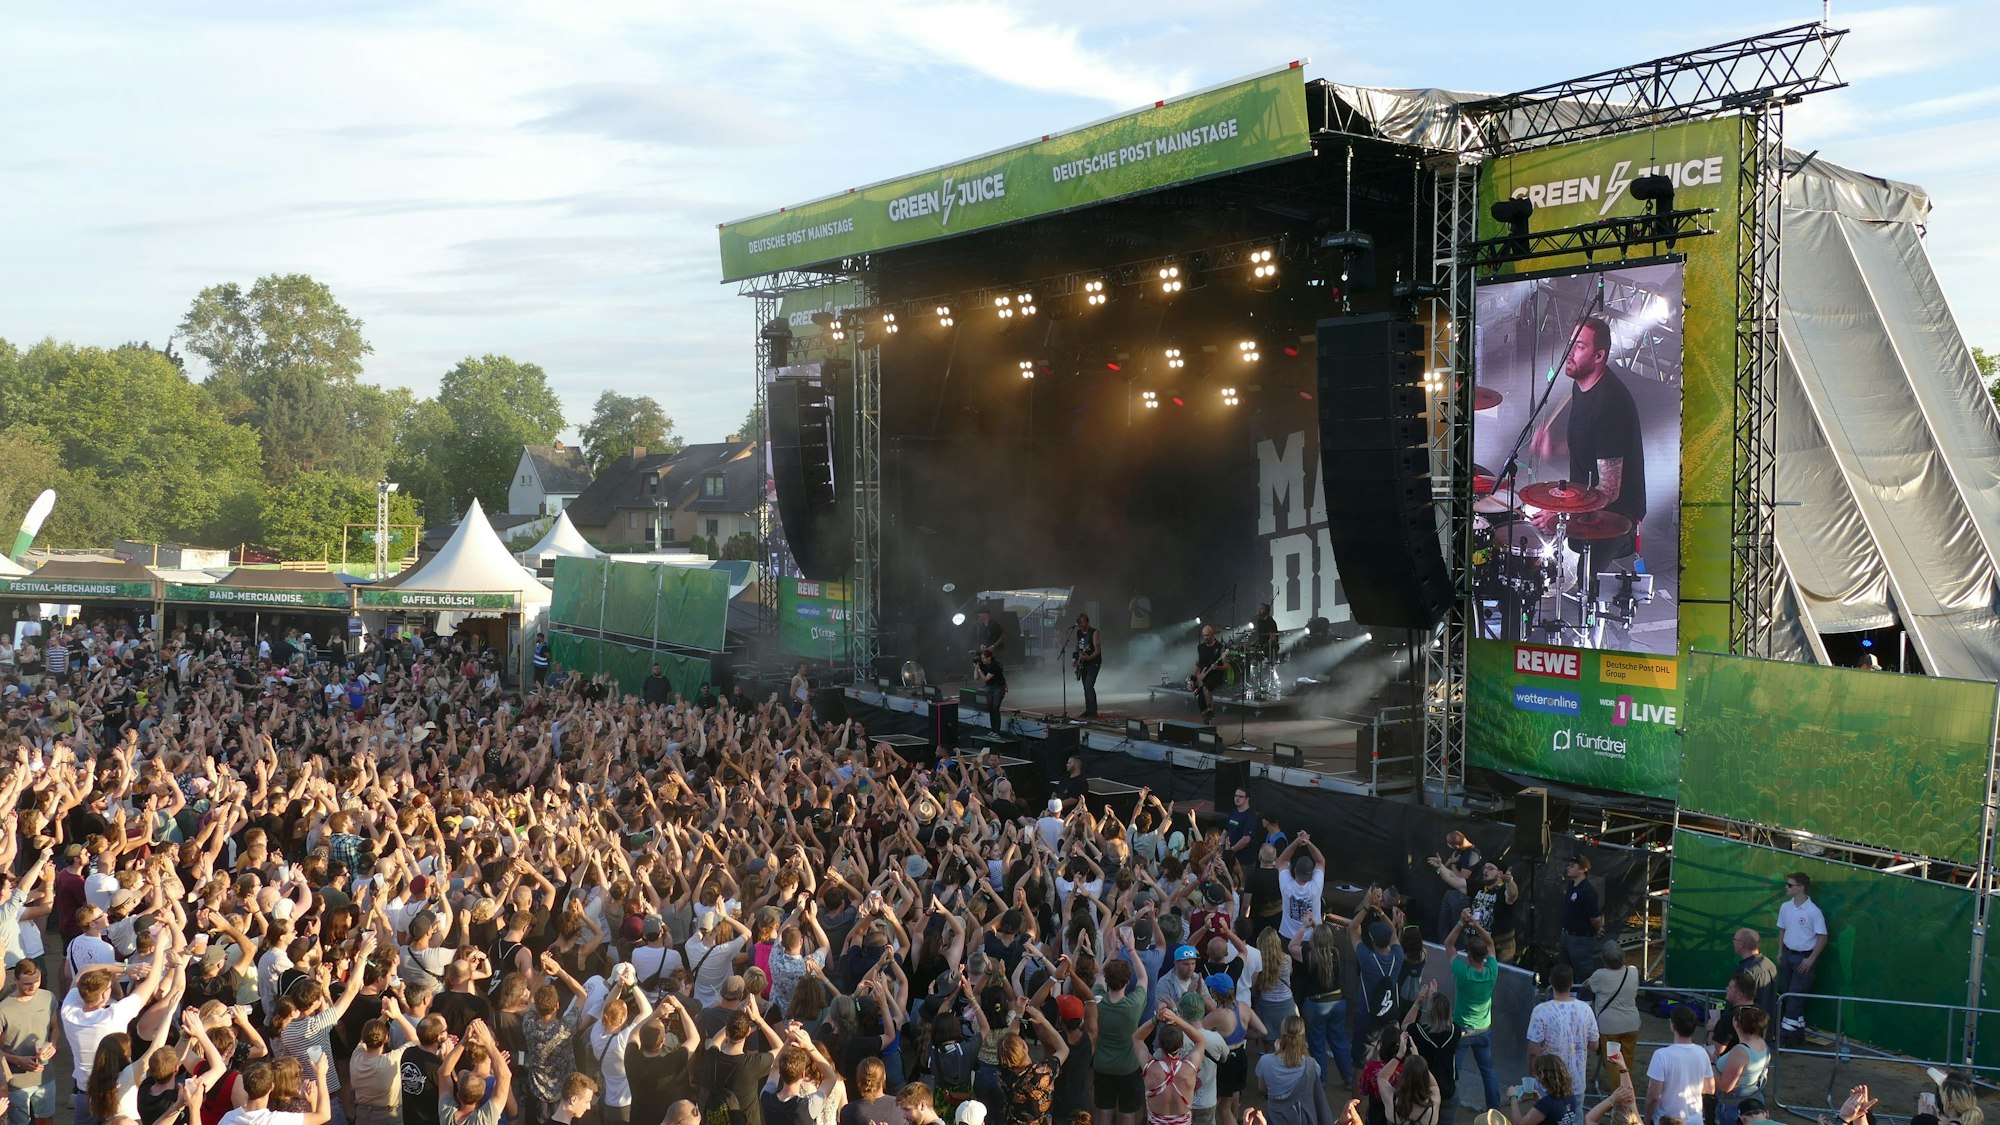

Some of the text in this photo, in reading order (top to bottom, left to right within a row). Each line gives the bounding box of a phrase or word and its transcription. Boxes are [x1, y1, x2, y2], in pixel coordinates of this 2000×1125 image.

[1053, 118, 1239, 183] DEUTSCHE POST MAINSTAGE
[888, 173, 1005, 222] GREEN JUICE
[748, 218, 854, 254] DEUTSCHE POST MAINSTAGE
[10, 582, 116, 594] FESTIVAL-MERCHANDISE
[797, 582, 820, 596] REWE
[209, 591, 303, 603] BAND-MERCHANDISE
[402, 594, 475, 606] GAFFEL KÖLSCH
[1517, 649, 1577, 676] REWE
[1606, 660, 1671, 674] Deutsche Post DHL
[1605, 669, 1627, 680] Group
[1516, 693, 1578, 709] wetteronline
[1599, 698, 1616, 707] WDR
[1576, 733, 1626, 753] fünfdrei
